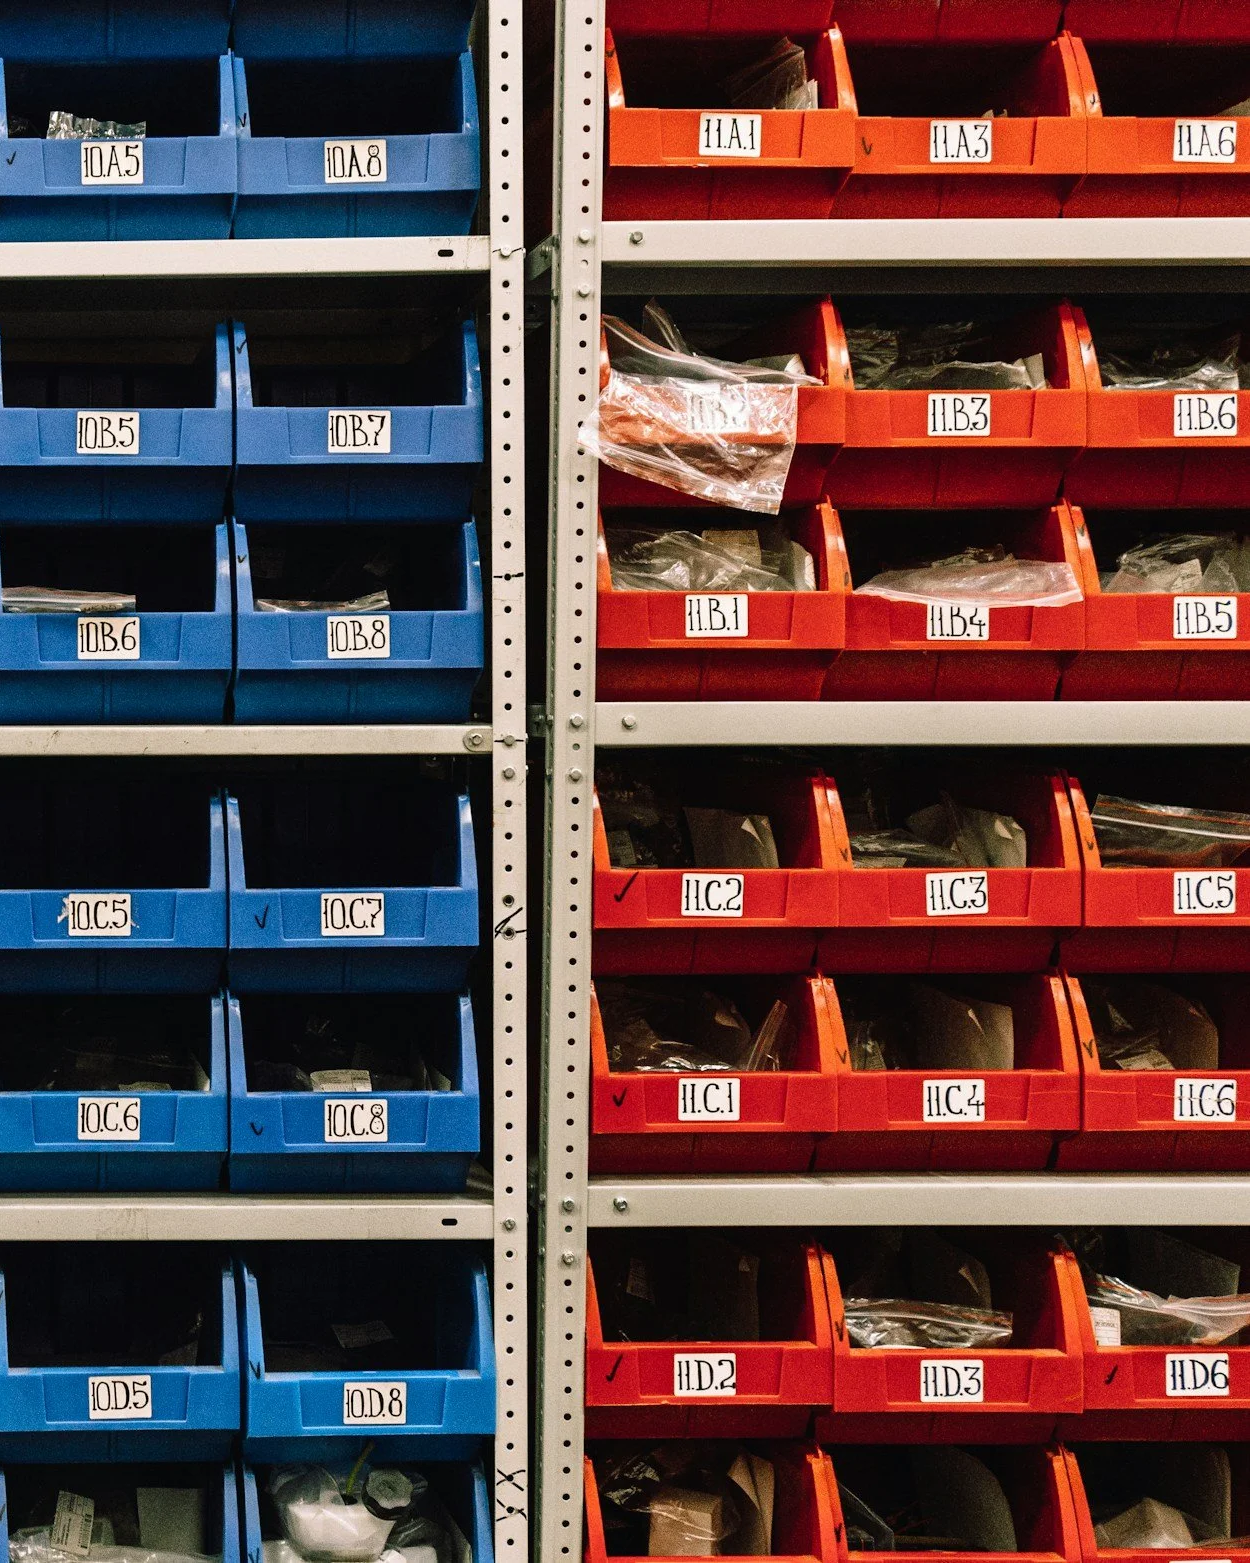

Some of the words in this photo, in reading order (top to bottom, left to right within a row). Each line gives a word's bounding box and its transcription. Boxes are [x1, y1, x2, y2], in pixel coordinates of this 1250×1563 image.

[704, 118, 755, 150] 11.A.1
[933, 124, 989, 158] 11.A.3
[1177, 124, 1236, 156] 11.A.6
[83, 145, 140, 178] 10.A.5
[326, 144, 382, 178] 10.A.8
[931, 397, 988, 433] 11.B.3
[1177, 396, 1236, 431] 11.B.6
[78, 416, 135, 450] 10.B.5
[330, 414, 386, 448] 10.B.7
[688, 597, 739, 631] 11.B.1
[930, 605, 986, 640] 11.B.4
[1176, 600, 1233, 635] 11.B.5
[79, 620, 137, 653] 10.B.6
[329, 619, 386, 653] 10.B.8
[684, 877, 742, 912] 11.C.2
[930, 876, 987, 911] 11.C.3
[1177, 875, 1234, 910] 11.C.5
[70, 898, 128, 931] 10.C.5
[323, 897, 382, 930] 10.C.7
[682, 1082, 734, 1114] 11.C.1
[927, 1084, 985, 1117] 11.C.4
[1178, 1082, 1236, 1117] 11.C.6
[80, 1101, 139, 1134] 10.C.6
[327, 1103, 385, 1138] 10.C.8
[677, 1359, 736, 1391] 11.D.2
[923, 1365, 981, 1397] 11.D.3
[1170, 1359, 1229, 1391] 11.D.6
[91, 1380, 150, 1412] 10.D.5
[346, 1387, 403, 1419] 10.D.8
